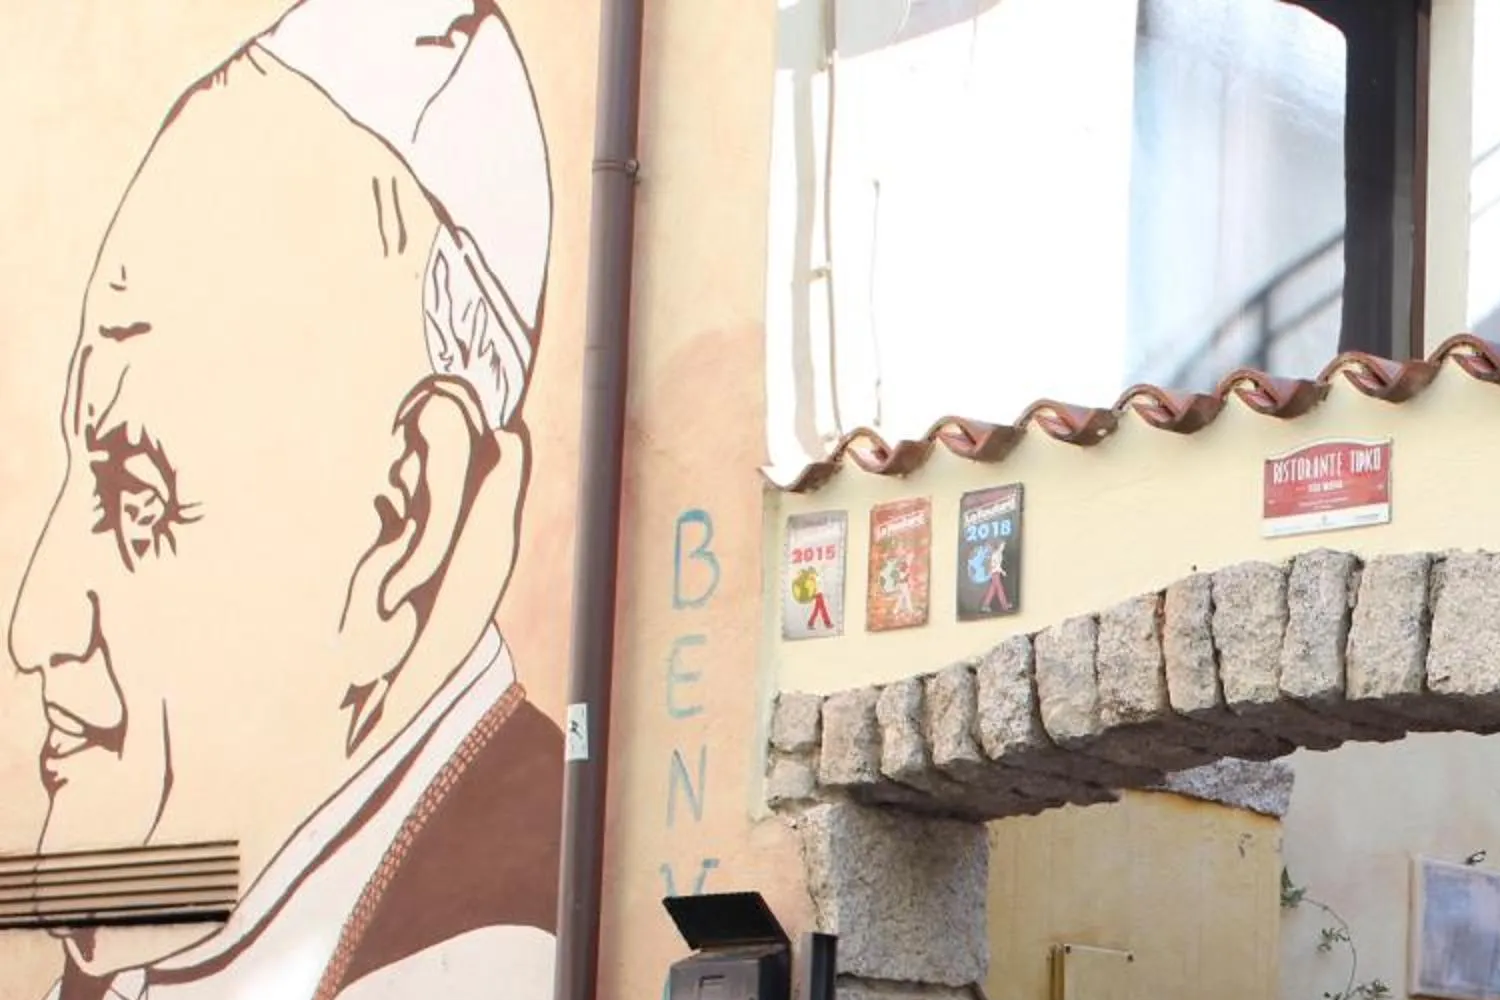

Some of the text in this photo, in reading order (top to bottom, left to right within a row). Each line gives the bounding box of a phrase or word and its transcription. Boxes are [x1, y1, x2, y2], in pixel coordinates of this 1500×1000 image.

[1273, 452, 1344, 485] RISTORANTE
[965, 519, 1013, 542] 2018
[791, 543, 837, 565] 2015
